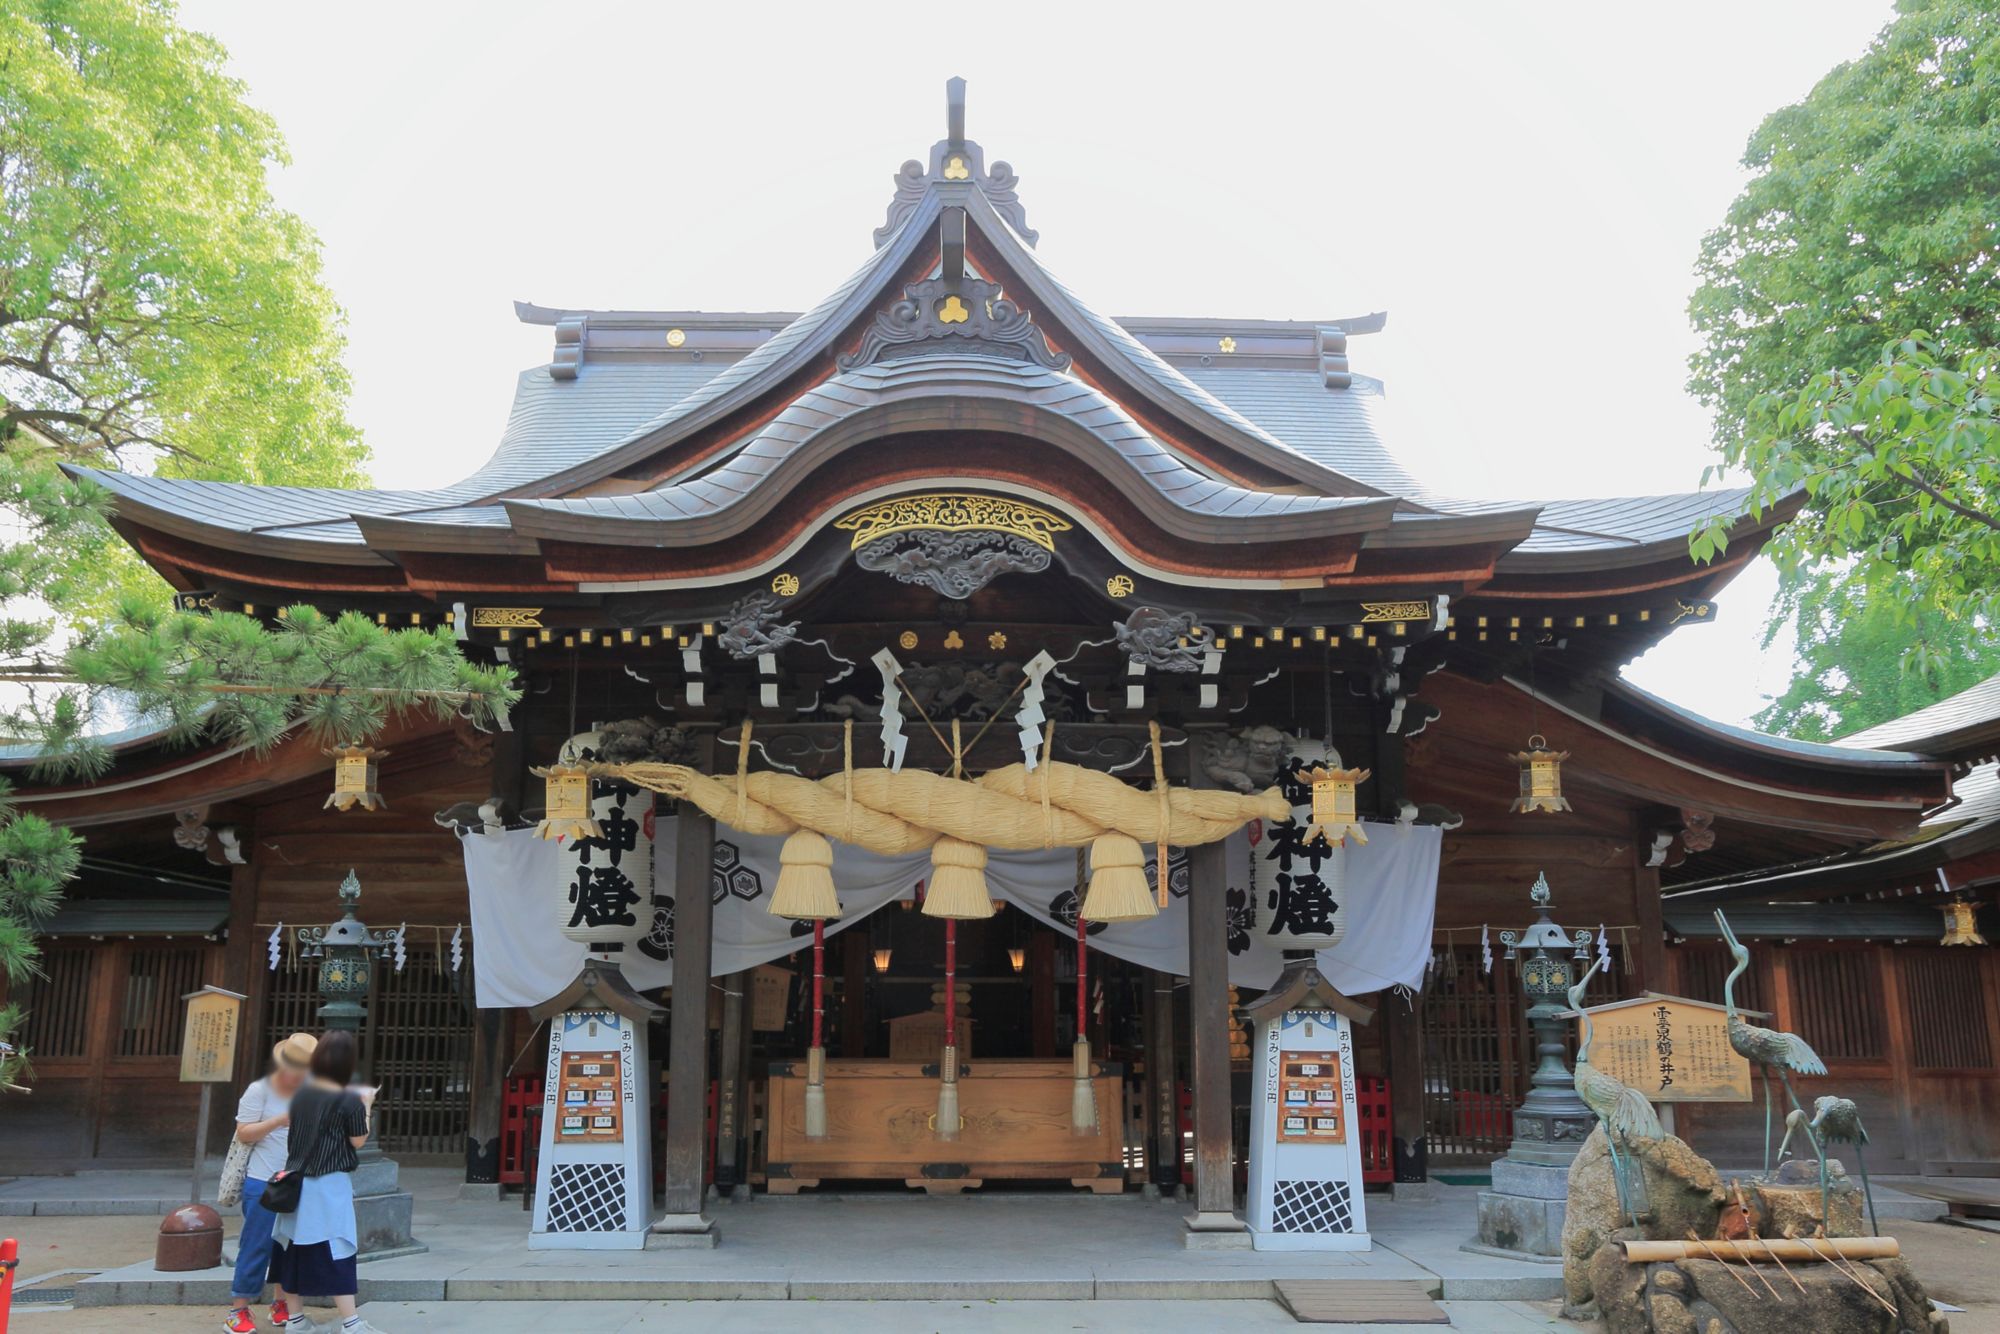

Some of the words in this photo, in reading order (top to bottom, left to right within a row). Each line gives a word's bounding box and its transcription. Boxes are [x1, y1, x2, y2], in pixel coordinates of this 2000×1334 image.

[546, 1032, 561, 1105] おみくじ50円
[622, 1030, 634, 1103] おみくじ50円
[1267, 1030, 1279, 1104] おみくじ50円
[1340, 1031, 1355, 1104] おみくじ50円
